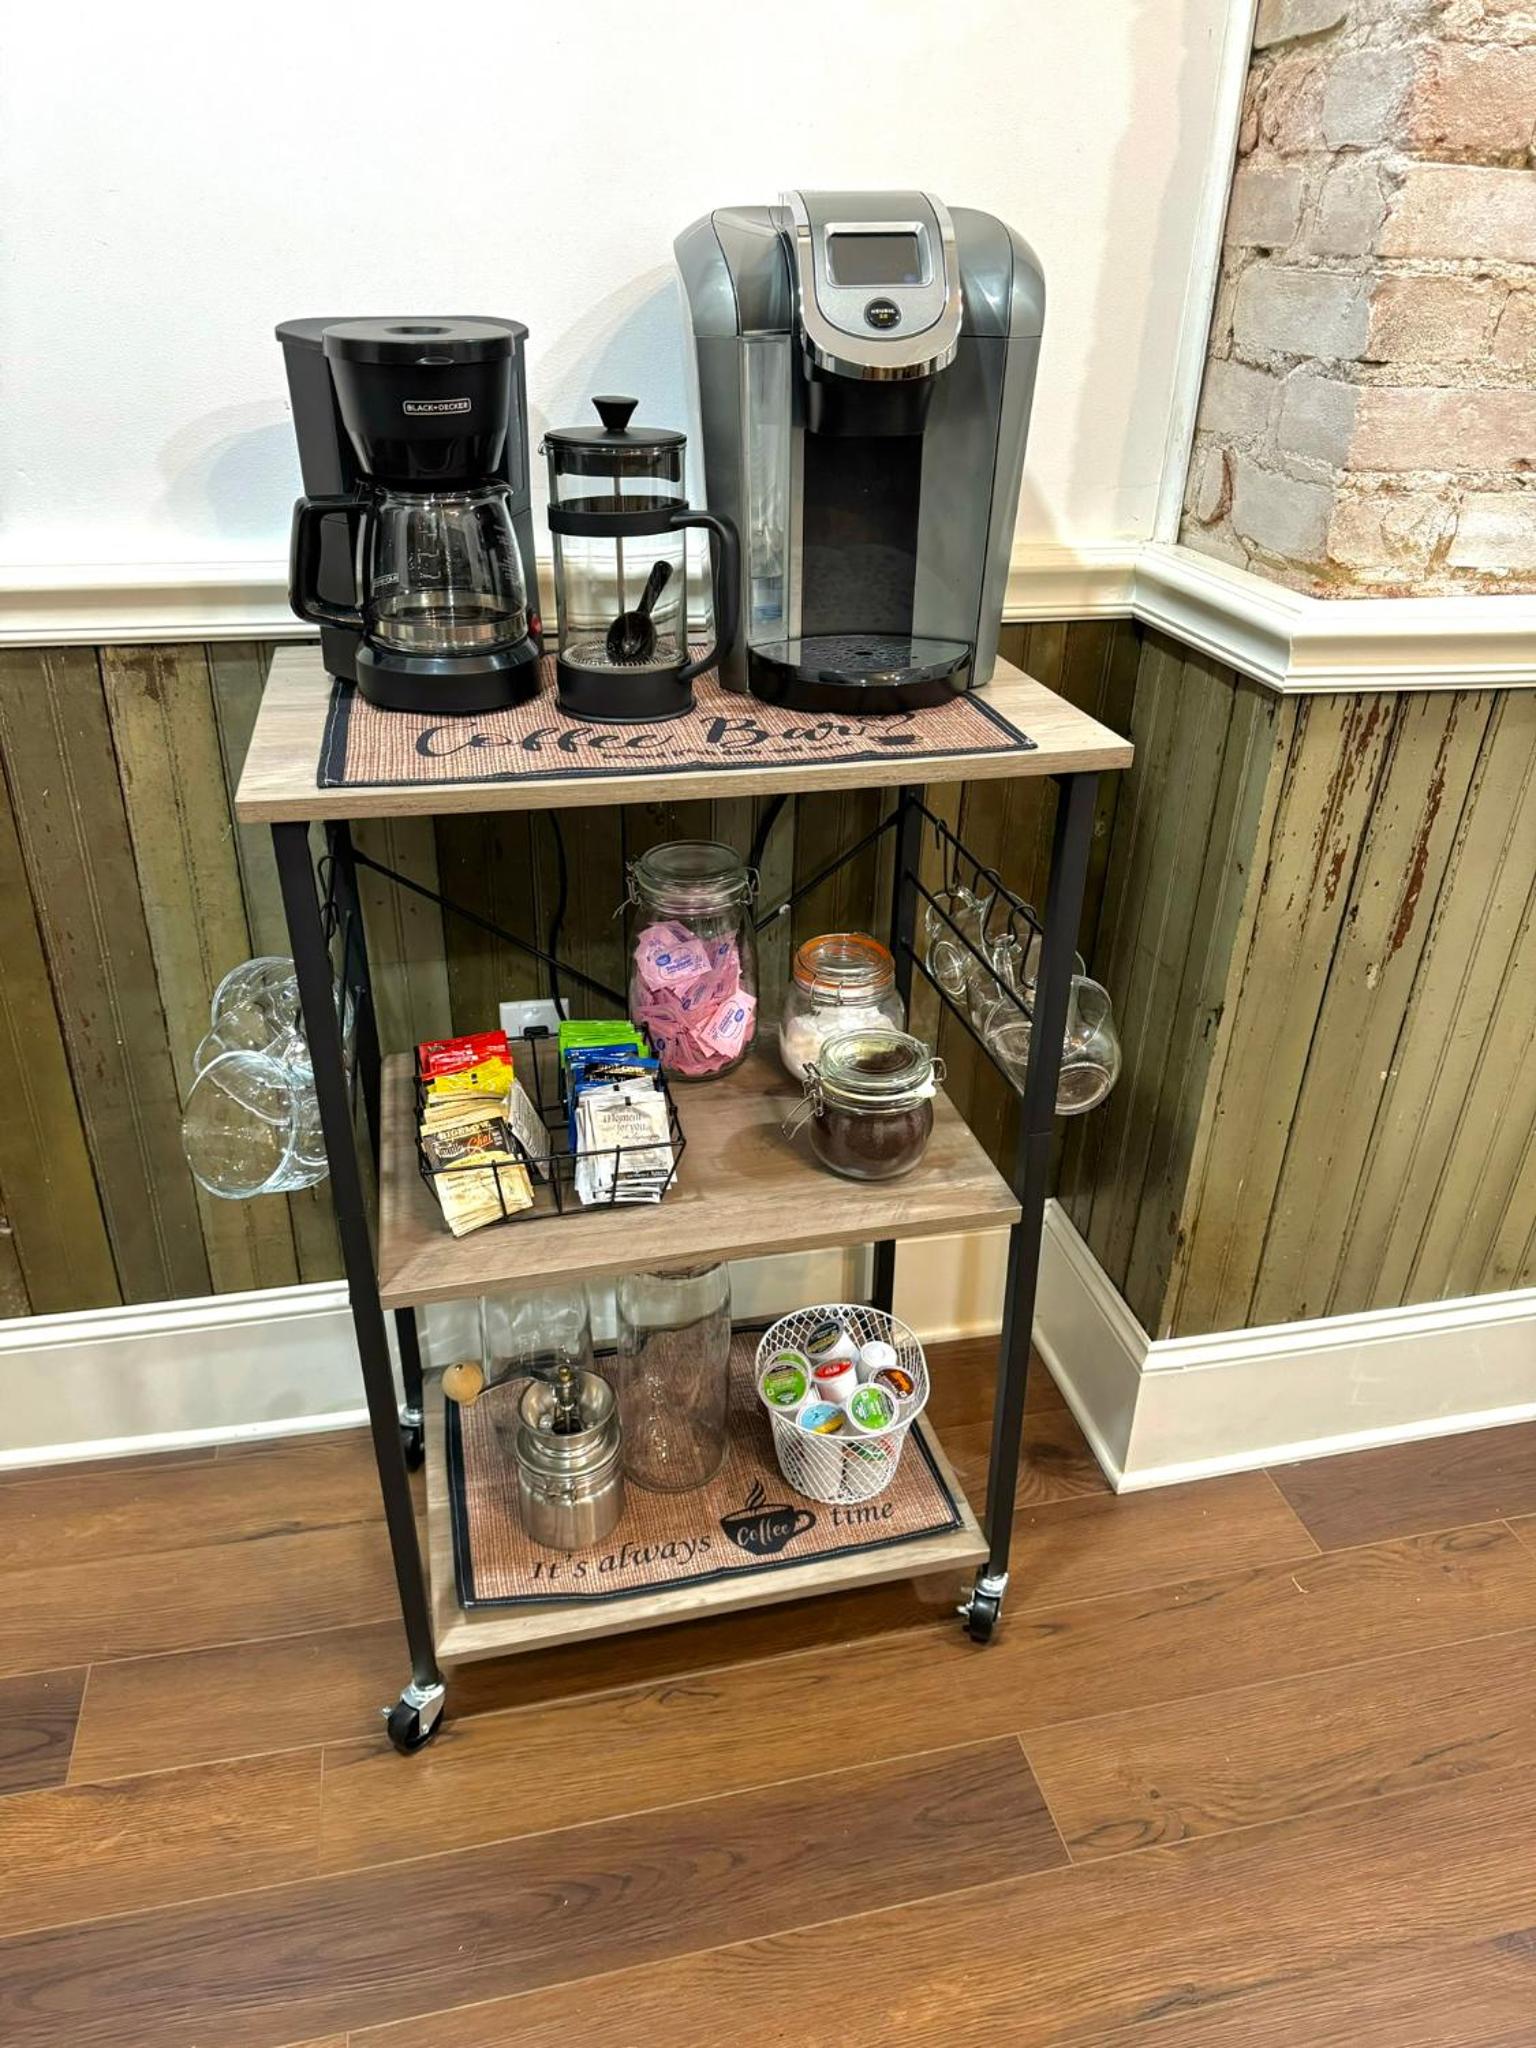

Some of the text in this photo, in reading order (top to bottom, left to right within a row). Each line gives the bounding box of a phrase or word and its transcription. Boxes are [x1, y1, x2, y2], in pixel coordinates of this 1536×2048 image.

[415, 715, 864, 757] Coffee Bar
[530, 1502, 894, 1581] It's always Coffee time
